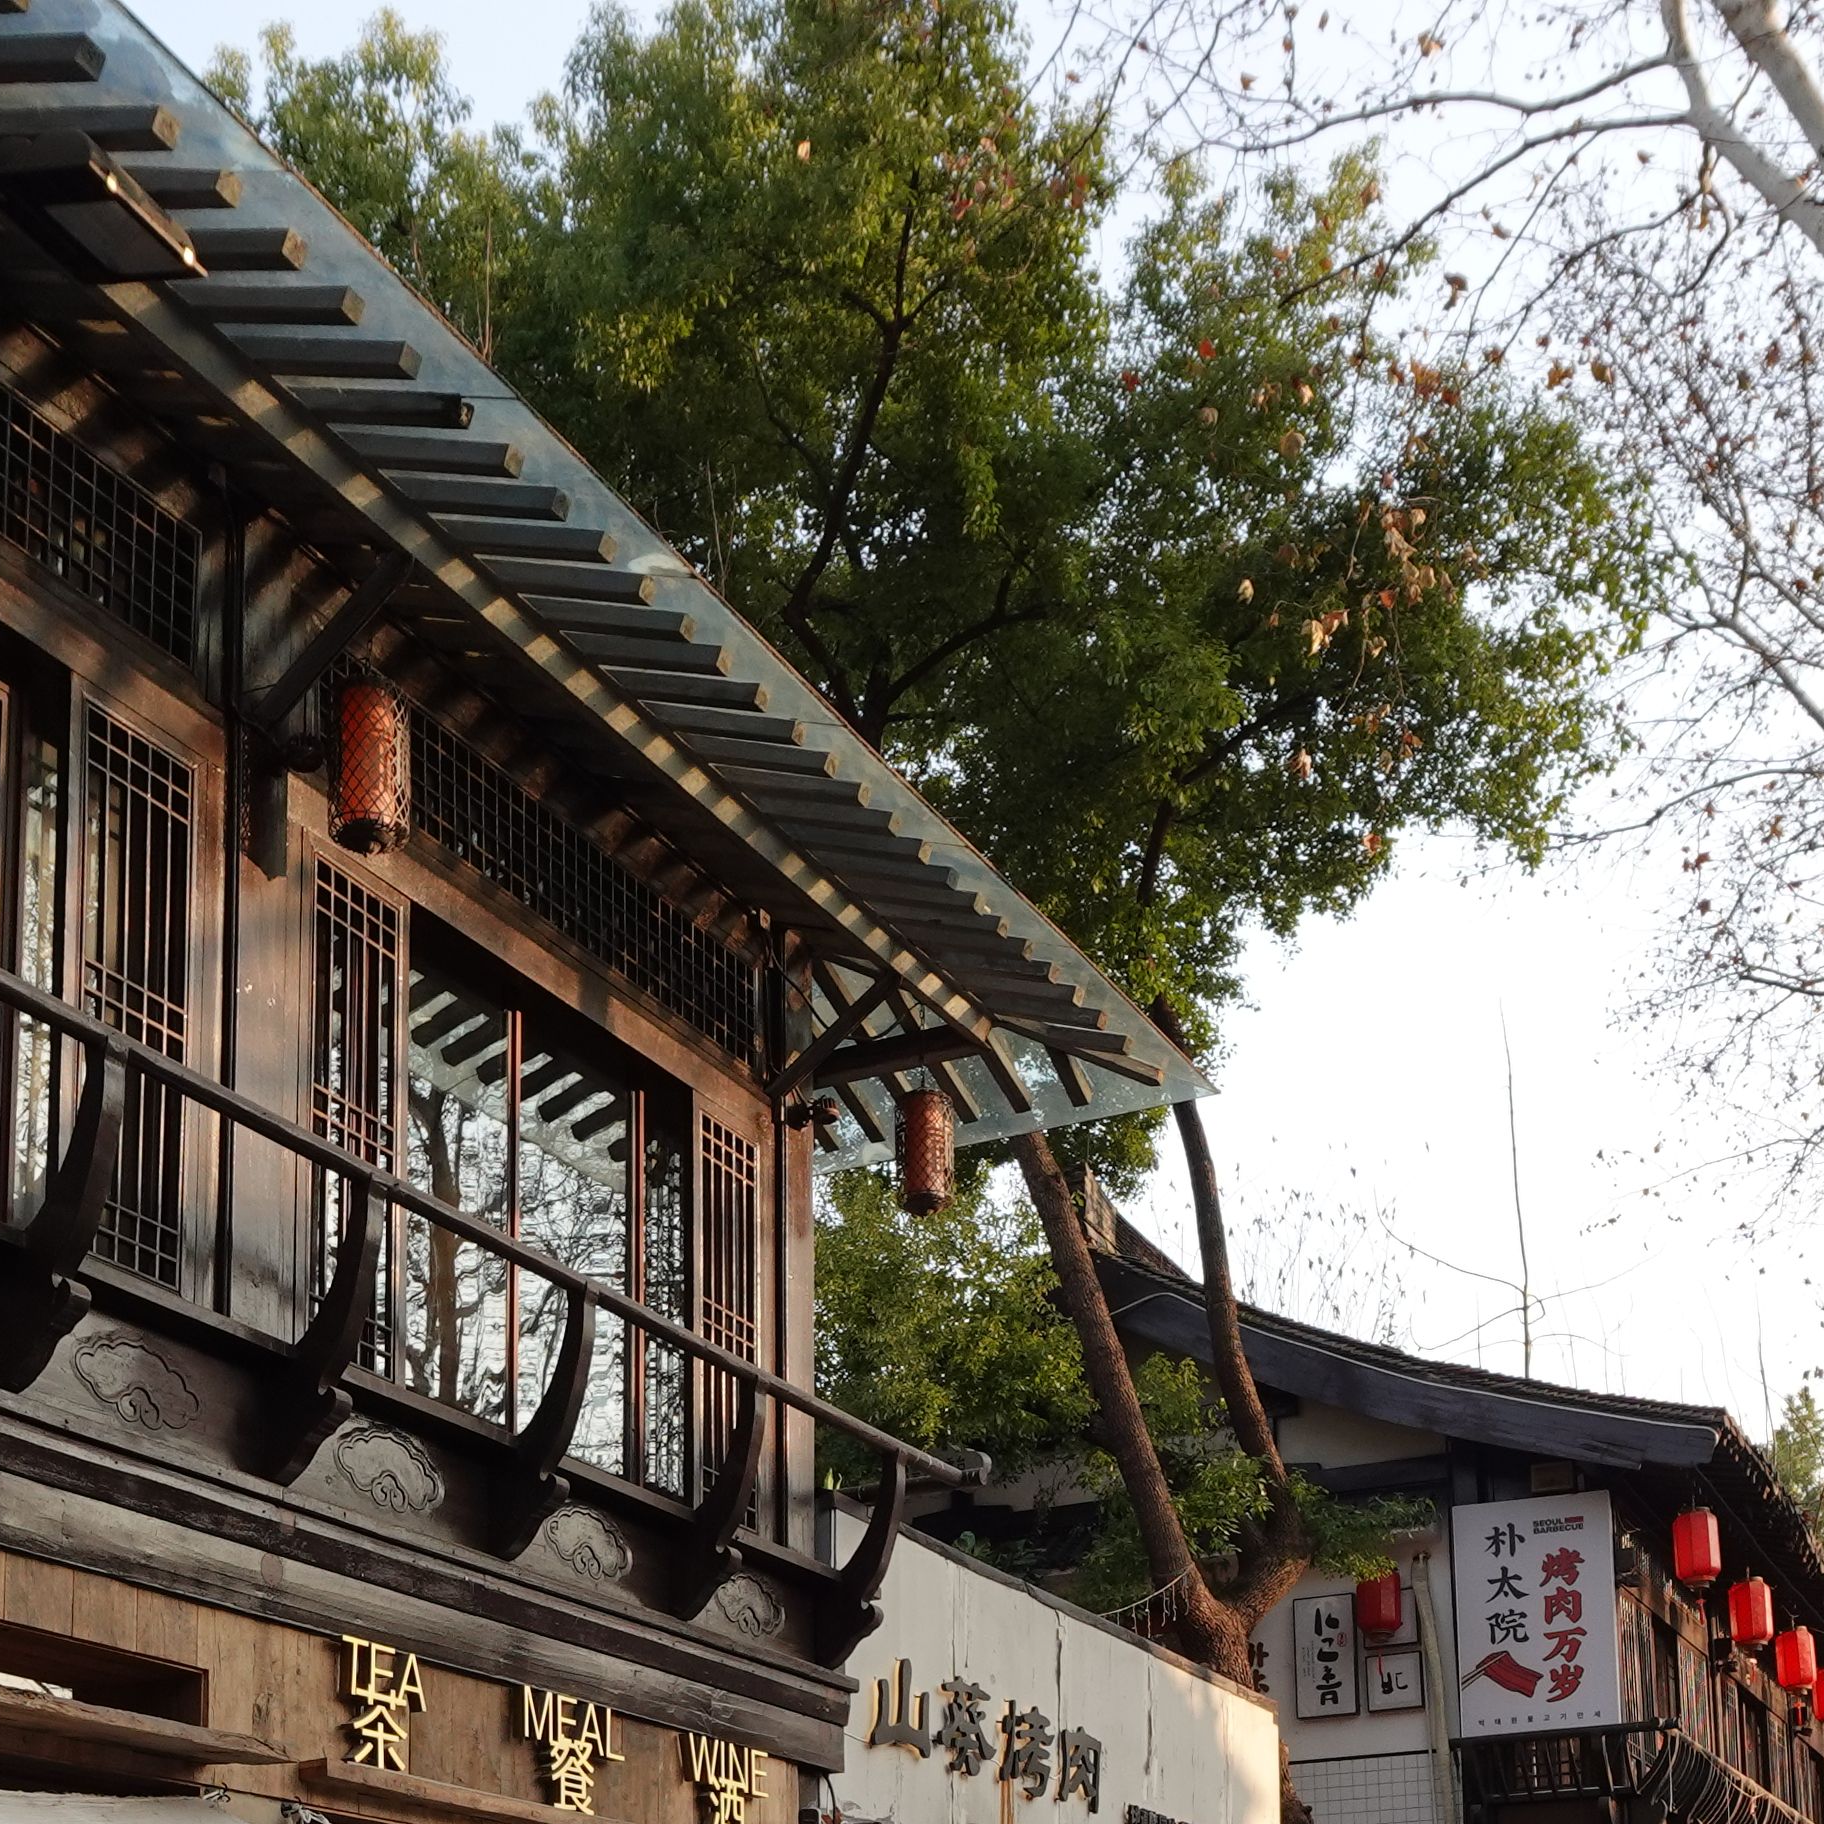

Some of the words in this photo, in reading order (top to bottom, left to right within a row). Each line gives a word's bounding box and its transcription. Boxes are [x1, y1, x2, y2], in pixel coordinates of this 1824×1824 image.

[1484, 1523, 1530, 1645] 朴太院
[1533, 1518, 1564, 1528] SEOUL
[1533, 1523, 1584, 1534] BARBECUE
[1539, 1547, 1587, 1703] 烤肉万岁
[342, 1634, 427, 1712] TEA
[523, 1685, 625, 1762] MEAL
[689, 1732, 769, 1798] WINE
[353, 1683, 408, 1771] 茶
[550, 1737, 594, 1816] 餐
[869, 1657, 1102, 1814] 山葵烤肉
